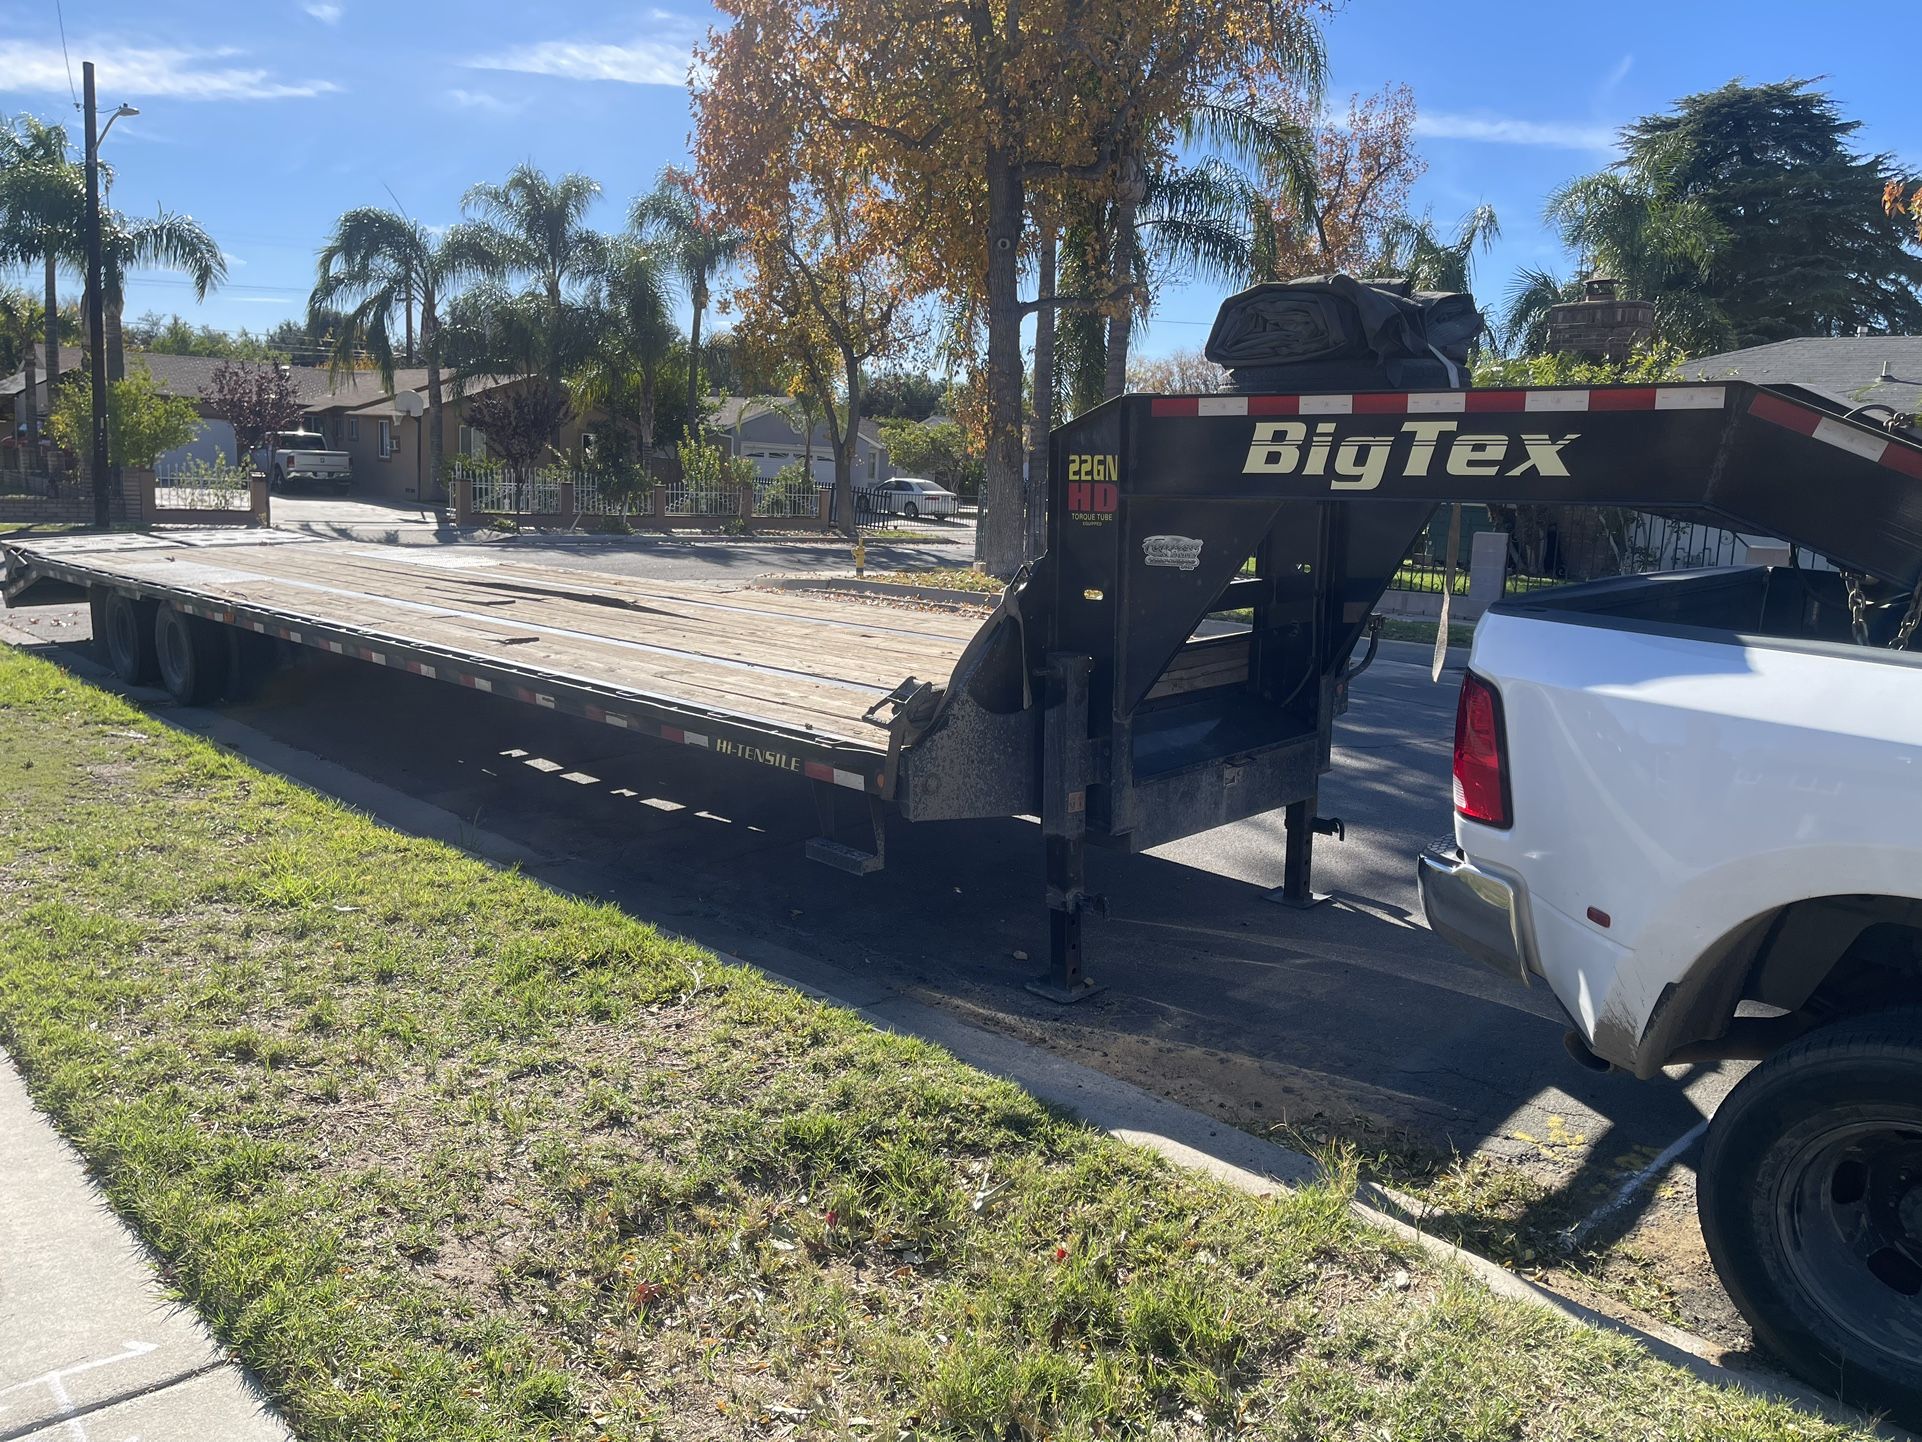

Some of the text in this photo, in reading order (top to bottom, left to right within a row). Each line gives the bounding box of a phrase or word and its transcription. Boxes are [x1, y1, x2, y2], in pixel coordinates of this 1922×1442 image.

[1068, 454, 1118, 481] 22GN
[1068, 482, 1118, 512] HD
[1071, 513, 1113, 521] TORQUE TUBE
[716, 738, 801, 772] HI-TENSILE
